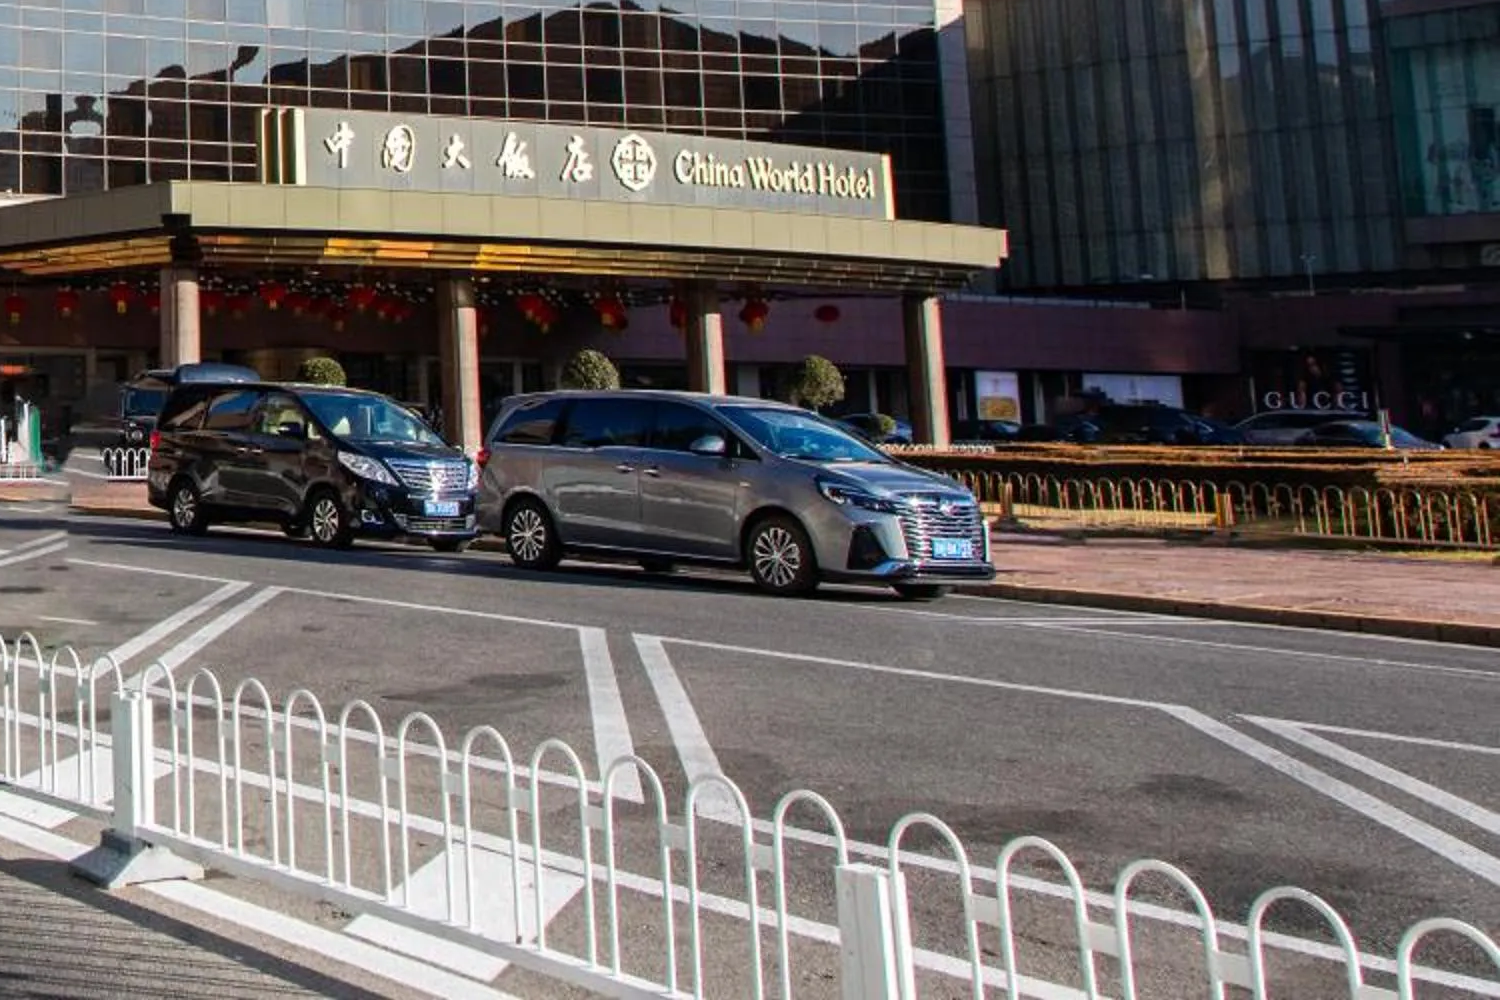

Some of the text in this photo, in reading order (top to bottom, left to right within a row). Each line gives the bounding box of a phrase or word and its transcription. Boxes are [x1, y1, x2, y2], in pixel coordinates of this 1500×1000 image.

[674, 149, 875, 199] China World Hotel
[1263, 391, 1370, 410] GUCCI
